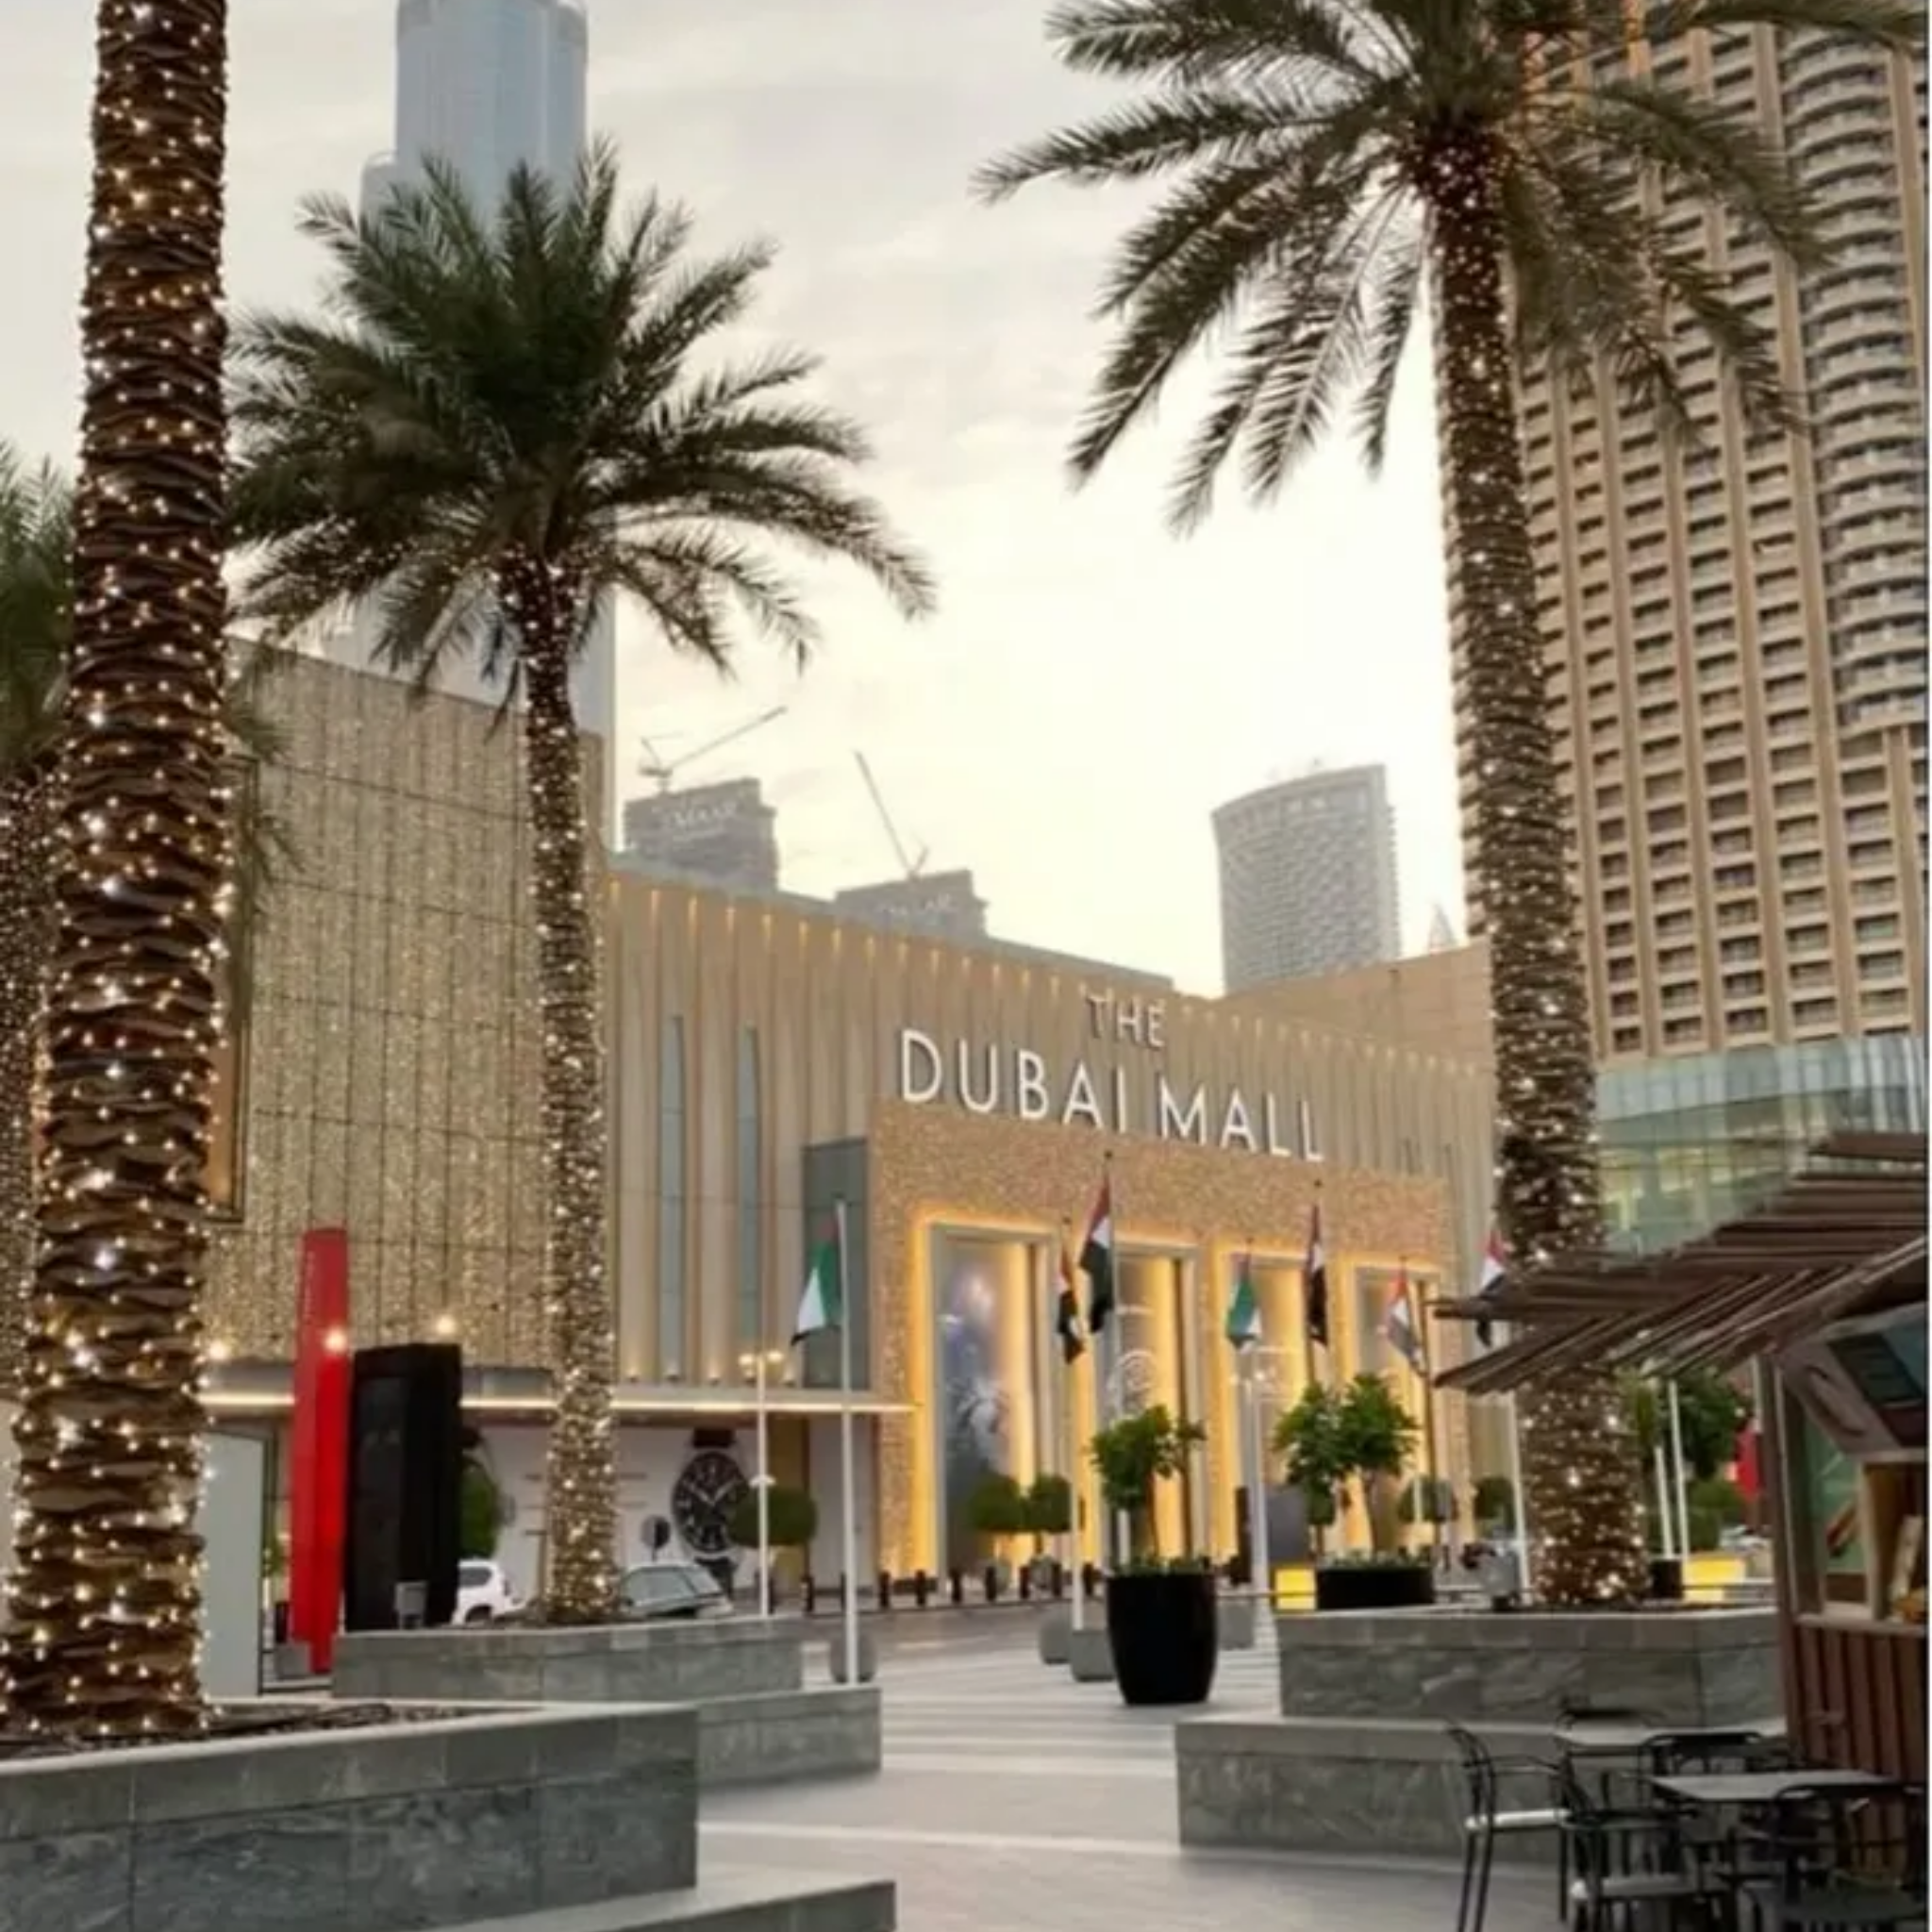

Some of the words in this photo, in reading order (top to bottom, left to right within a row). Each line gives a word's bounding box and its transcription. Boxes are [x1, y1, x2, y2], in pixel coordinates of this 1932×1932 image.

[1087, 991, 1166, 1048] THE
[901, 1029, 1126, 1134] DUBAI
[1158, 1075, 1324, 1163] MALL
